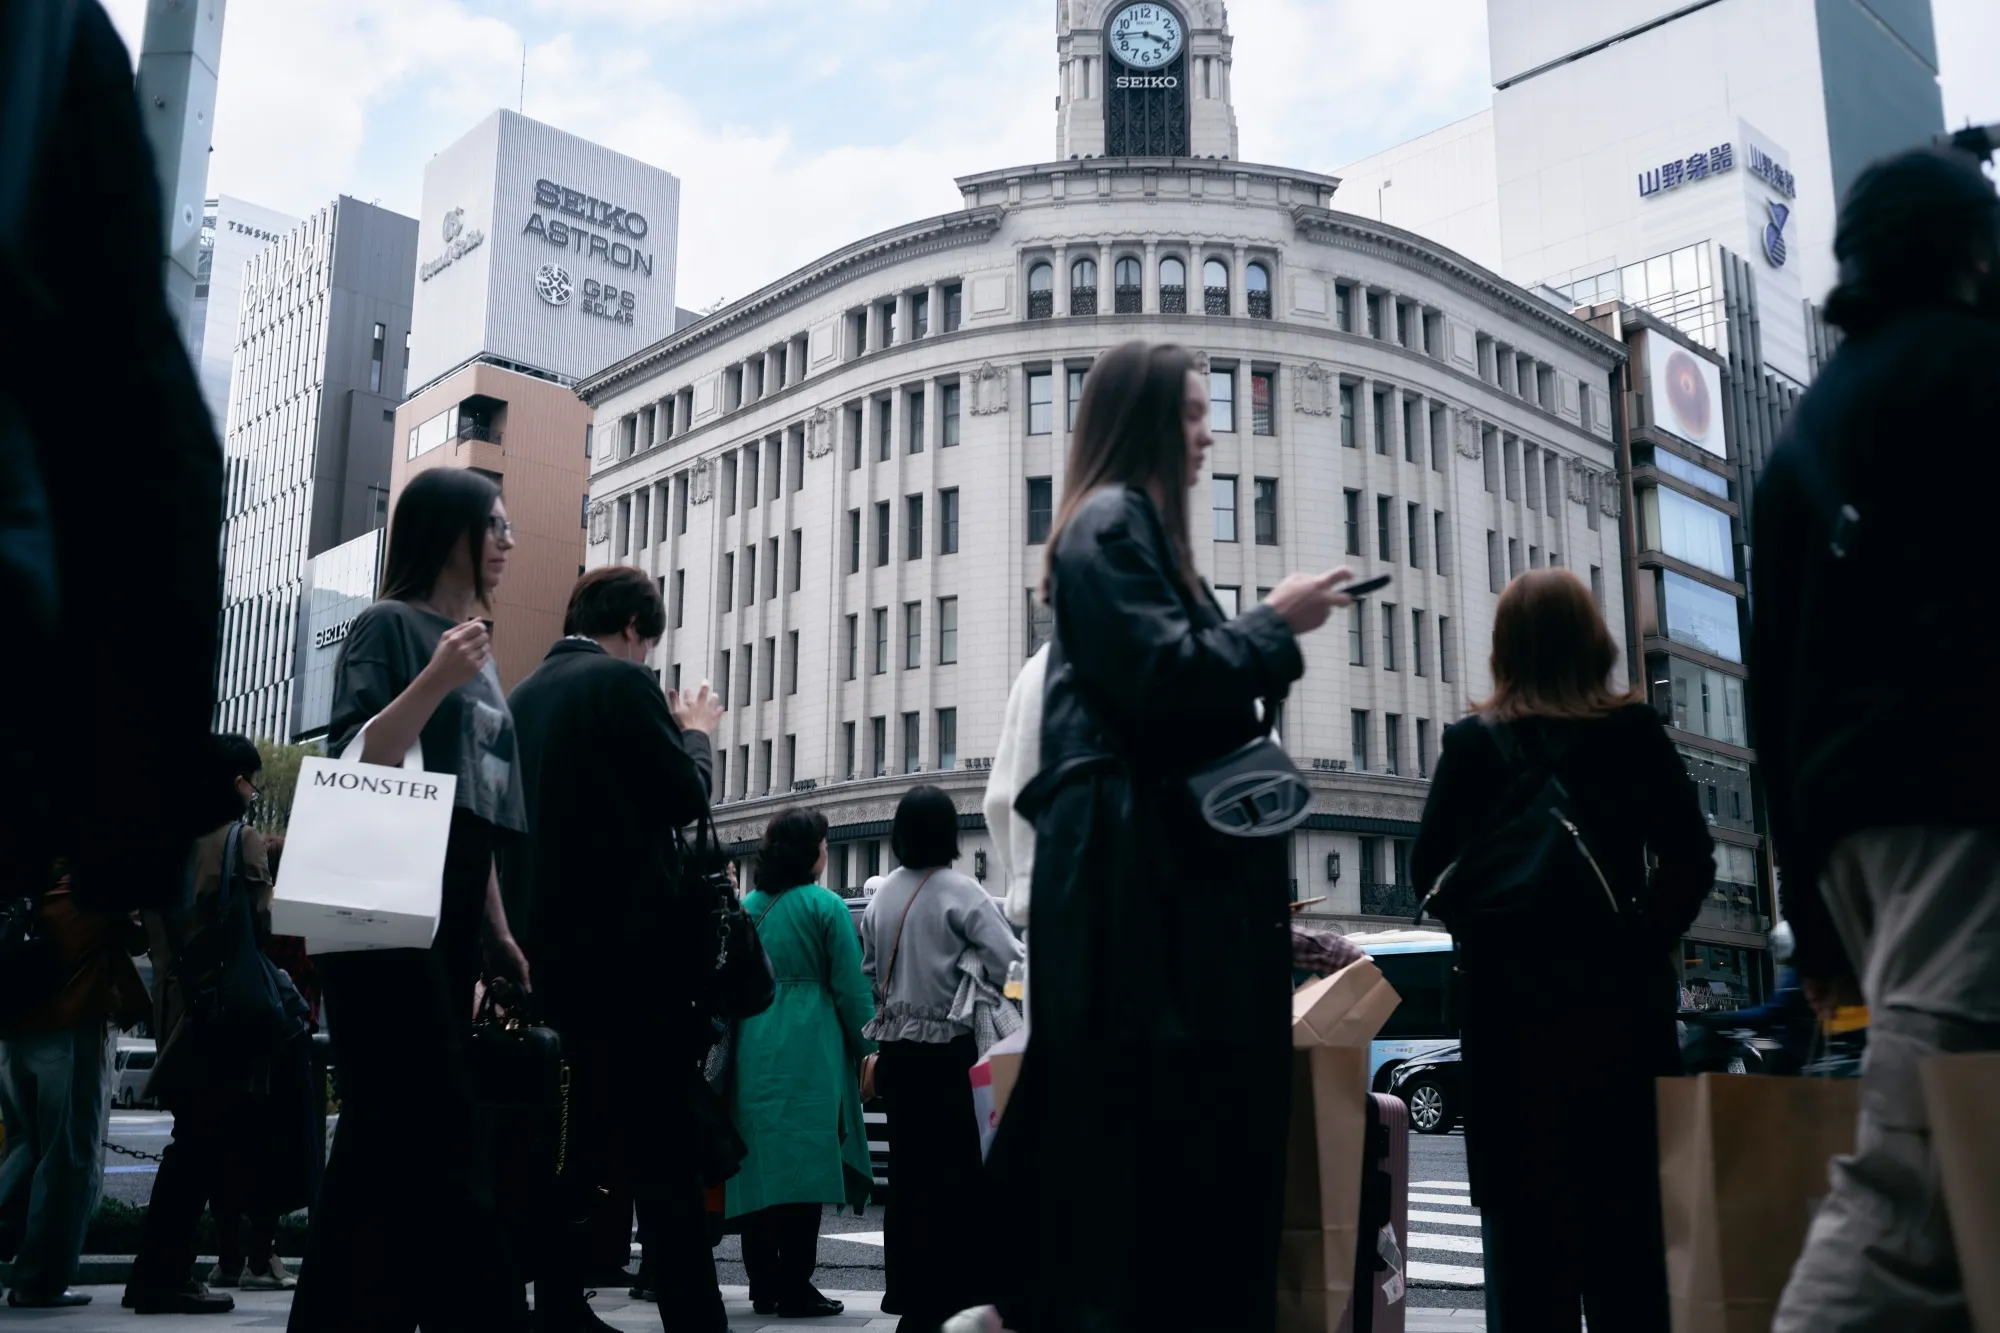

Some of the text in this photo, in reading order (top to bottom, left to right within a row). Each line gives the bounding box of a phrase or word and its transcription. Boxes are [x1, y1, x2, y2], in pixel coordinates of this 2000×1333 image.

[1130, 11, 1138, 20] 11
[1141, 8, 1151, 18] 12
[1156, 11, 1159, 20] 1
[1120, 19, 1130, 29] 10
[1163, 18, 1171, 29] 2
[1167, 30, 1175, 40] 3
[1120, 40, 1129, 51] 8
[1162, 41, 1171, 51] 4
[1131, 49, 1140, 59] 7
[1141, 51, 1150, 62] 6
[1153, 49, 1162, 59] 5
[1116, 76, 1178, 88] SEIKO
[1638, 142, 1733, 197] 山野楽器
[534, 178, 648, 240] SEIKO
[522, 212, 653, 277] ASTRON
[243, 233, 324, 312] GUCCI
[583, 278, 635, 310] GPS
[581, 298, 634, 327] SOLAR
[314, 770, 438, 800] MONSTER
